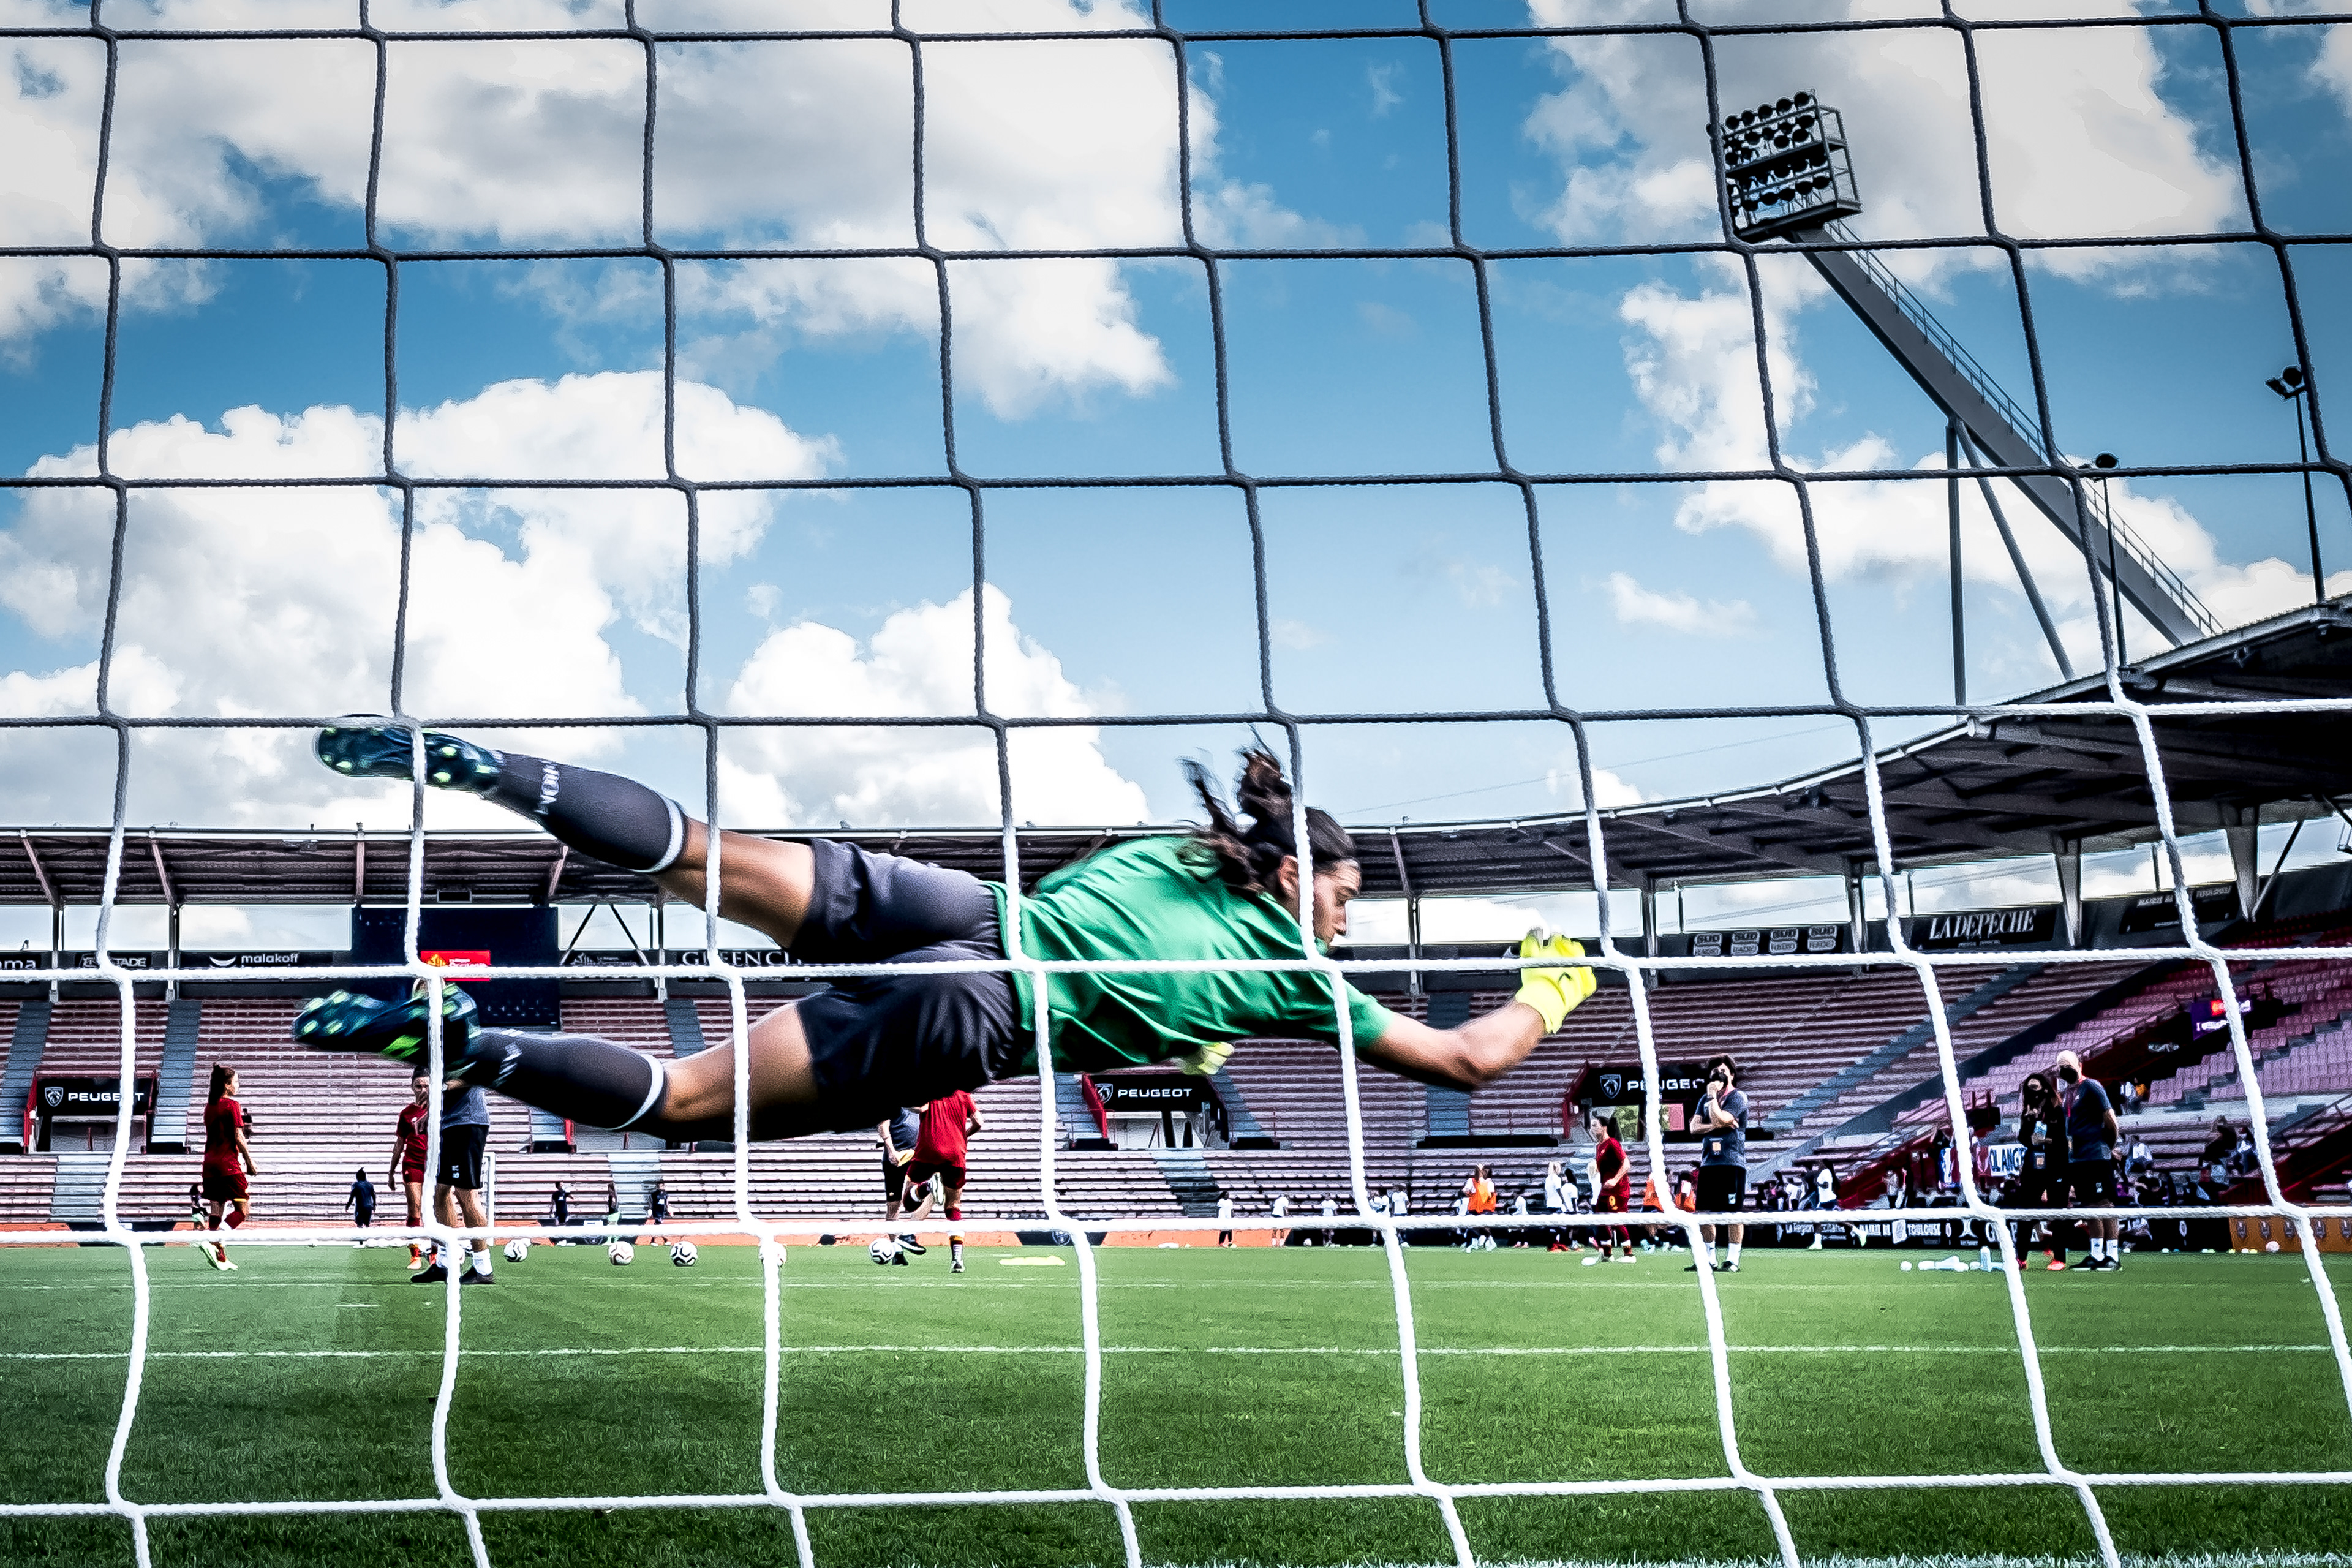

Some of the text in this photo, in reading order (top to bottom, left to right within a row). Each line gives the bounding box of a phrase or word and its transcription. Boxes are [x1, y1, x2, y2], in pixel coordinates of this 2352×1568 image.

[241, 953, 298, 963] malakoff
[0, 960, 36, 969] ma
[68, 1093, 145, 1101] PEUGET
[1117, 1088, 1193, 1098] PEUGEOT
